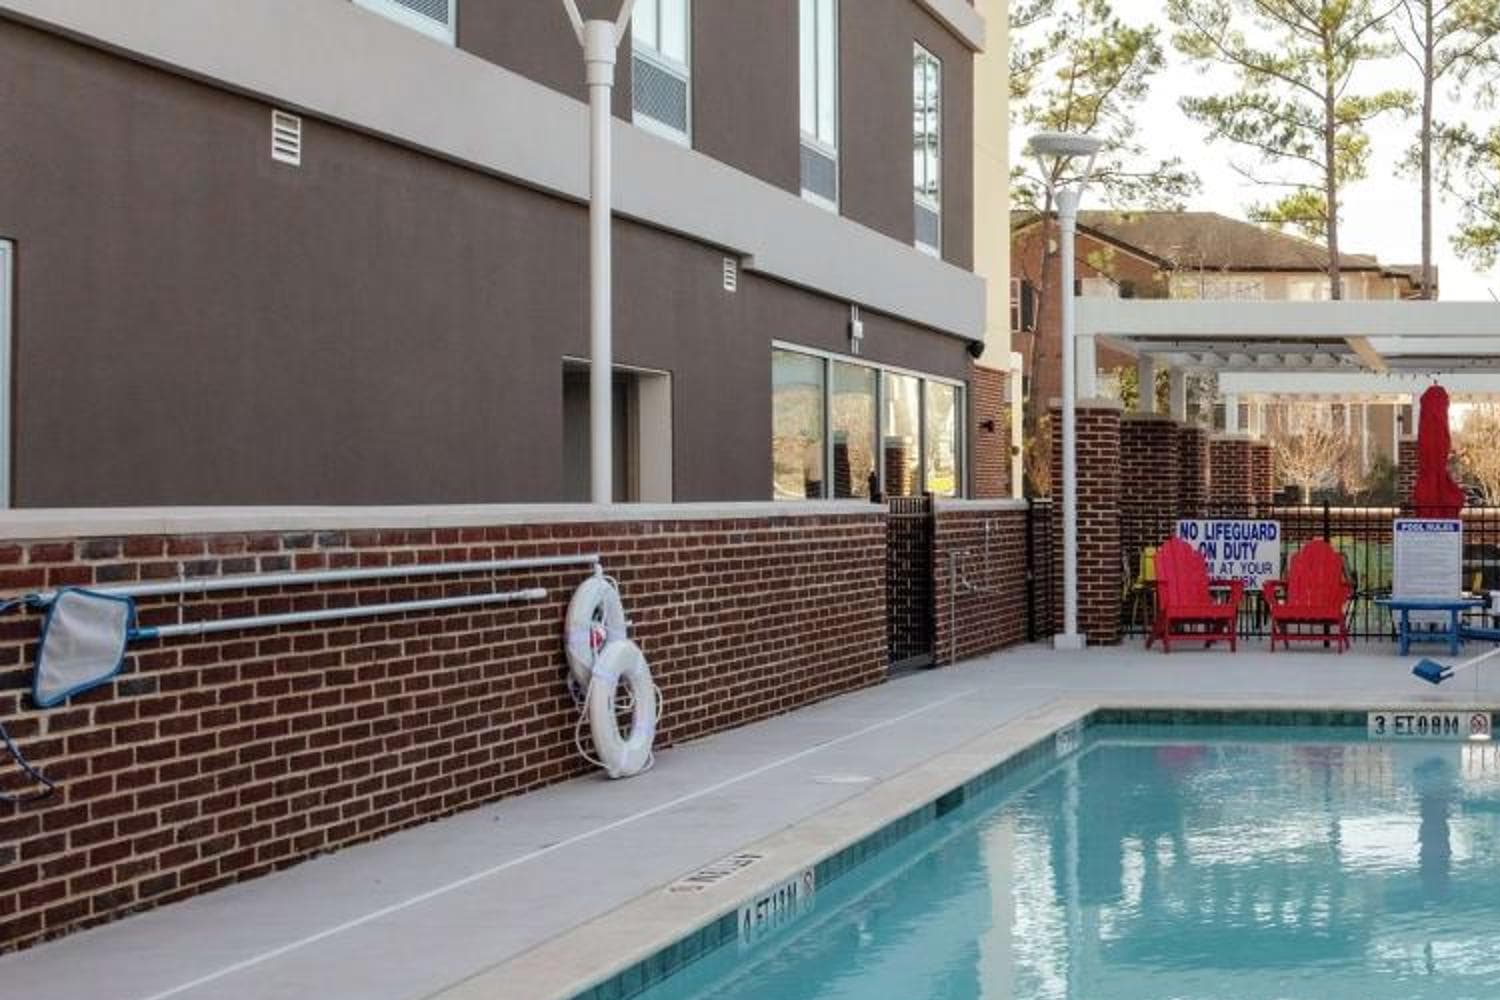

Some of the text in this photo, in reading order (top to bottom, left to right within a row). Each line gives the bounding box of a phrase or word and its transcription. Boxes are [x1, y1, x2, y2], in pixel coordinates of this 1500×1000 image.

[1180, 522, 1278, 541] NO LIFEGUARD
[1223, 542, 1257, 561] DUTY
[1219, 562, 1235, 575] AT
[1240, 562, 1273, 575] YOUR
